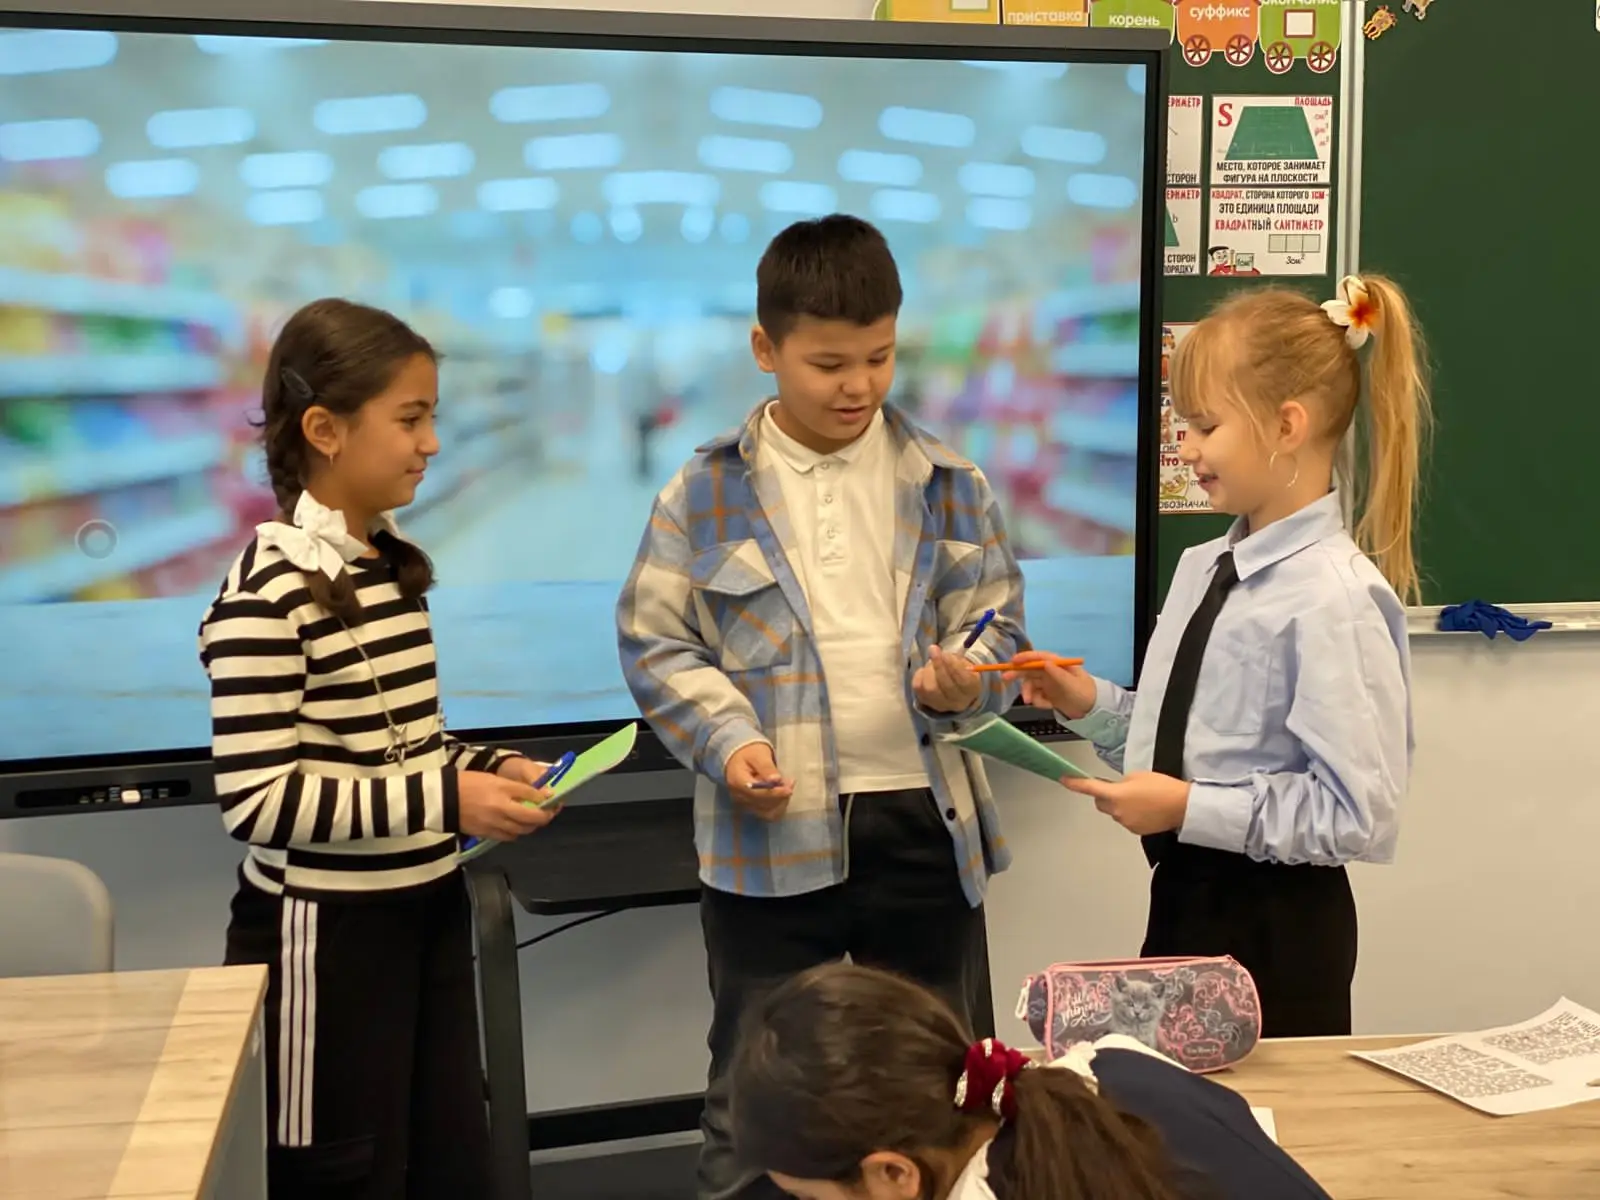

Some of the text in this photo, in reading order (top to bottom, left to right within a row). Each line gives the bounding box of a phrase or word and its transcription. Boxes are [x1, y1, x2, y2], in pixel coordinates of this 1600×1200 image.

[1008, 11, 1083, 24] приставка
[1190, 3, 1250, 20] суффикс
[1109, 14, 1160, 27] корень
[1217, 103, 1233, 127] S
[1216, 161, 1326, 171] МЕСТО, КОТОРОЕ ЗАНИМАЕТ
[1223, 173, 1318, 184] ФИГУРА НА ПЛОСКОСТИ
[1246, 190, 1275, 199] СТОРОНА
[1277, 190, 1309, 199] КОТОРОГО
[1219, 203, 1319, 214] ЭТО ЕДИНИЦА ПЛОЩАДИ
[1215, 217, 1324, 230] КВАДРАТНЫЙ САНТИМЕТР
[1167, 254, 1196, 263] СТОРОН
